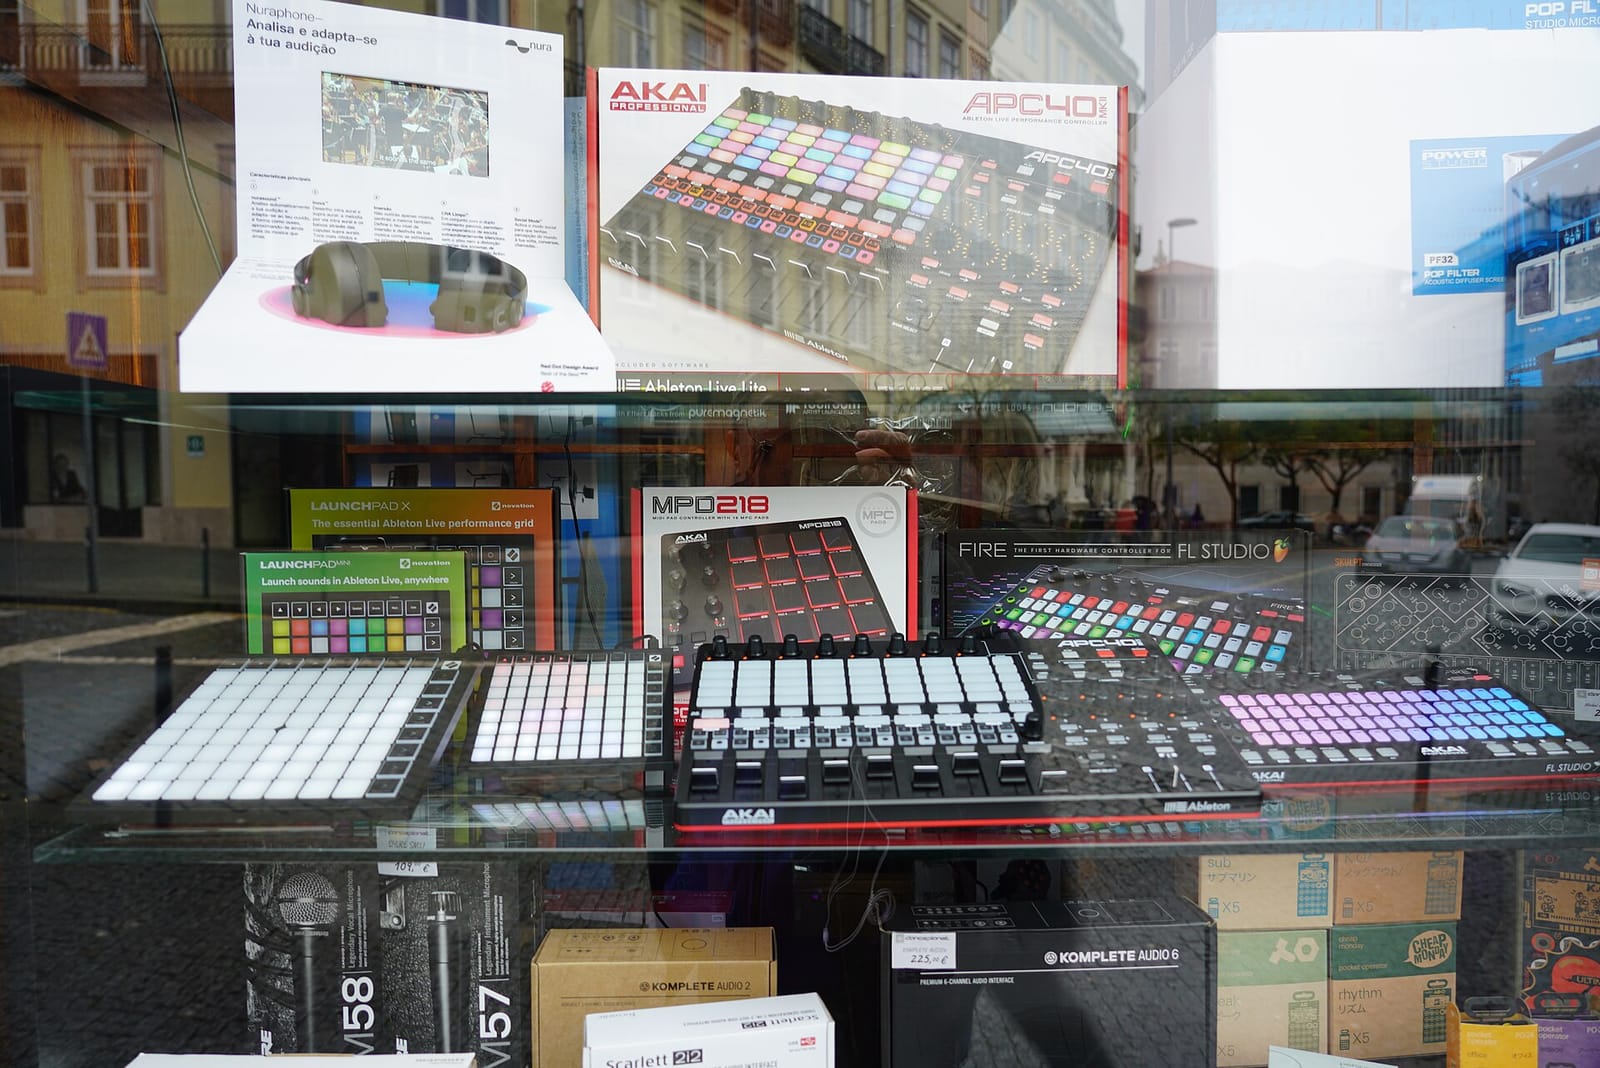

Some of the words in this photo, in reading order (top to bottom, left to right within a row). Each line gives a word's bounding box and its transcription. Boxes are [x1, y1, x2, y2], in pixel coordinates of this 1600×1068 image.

[1525, 2, 1565, 17] POP
[1571, 0, 1600, 14] FIL
[246, 18, 295, 34] Analisa
[299, 27, 307, 36] e
[1525, 17, 1566, 30] STUDIO
[247, 33, 255, 45] à
[260, 36, 281, 48] tua
[285, 41, 337, 56] audição
[529, 39, 553, 53] nura
[610, 80, 707, 103] AKAI
[611, 102, 706, 113] PROFESSIONAL
[962, 92, 1098, 118] APC40
[1064, 118, 1109, 126] CONTROLLER
[1422, 150, 1488, 161] POWER
[1023, 150, 1109, 179] APC40
[1429, 255, 1454, 264] PF32
[1424, 270, 1443, 279] POP
[1447, 268, 1481, 277] FILTER
[1424, 278, 1455, 286] ACOUSTIC
[1456, 277, 1485, 285] DIFFUSER
[806, 339, 849, 362] Ableton
[645, 378, 703, 393] Ableton
[688, 405, 768, 422] puremagnetik
[310, 501, 399, 512] LAUNCHPAD
[401, 501, 411, 511] X
[652, 495, 769, 514] MPD218
[862, 510, 895, 521] MPC
[312, 519, 332, 529] The
[333, 519, 380, 529] essential
[382, 519, 423, 529] Ableton
[425, 519, 446, 529] Live
[448, 519, 512, 531] performance
[514, 518, 534, 531] grid
[798, 520, 842, 530] MPD218
[675, 532, 707, 543] AKAI
[959, 542, 1007, 558] FIRE
[1178, 543, 1196, 559] FL
[1199, 543, 1270, 560] STUDIO
[259, 560, 336, 570] LAUNCHPAD
[1334, 557, 1363, 567] SKULPT
[261, 576, 296, 586] Launch
[297, 576, 331, 586] sounds
[332, 576, 341, 585] in
[343, 576, 379, 586] Ableton
[381, 576, 403, 586] Live,
[404, 576, 449, 587] anywhere
[1269, 603, 1296, 611] FIRE
[1545, 763, 1555, 773] FL
[1557, 762, 1592, 773] STUDIO
[1186, 801, 1231, 813] Ableton
[721, 808, 775, 820] AKAI
[1207, 856, 1232, 869] sub
[1207, 872, 1257, 883] サブマリン
[1222, 901, 1241, 913] X5
[1356, 901, 1375, 913] X5
[346, 912, 355, 931] Vocal
[483, 899, 491, 939] Instrument
[1412, 933, 1447, 954] CHEAP
[347, 932, 357, 969] Legendary
[1059, 950, 1136, 964] KOMPLETE
[1137, 949, 1170, 962] AUDIO
[1171, 949, 1180, 960] 6
[1413, 943, 1449, 964] MONDAY
[483, 940, 493, 977] Legendary
[1338, 964, 1361, 972] pocket
[651, 981, 715, 992] KOMPLETE
[717, 981, 743, 991] AUDIO
[743, 980, 751, 991] 2
[919, 978, 943, 986] PREMIUM
[988, 976, 1015, 984] INTERFACE
[1338, 987, 1383, 1002] rhythm
[1338, 1003, 1367, 1015] リズム
[770, 1014, 820, 1026] Scarlett
[1352, 1031, 1370, 1044] X5
[606, 1054, 668, 1068] Scarlett
